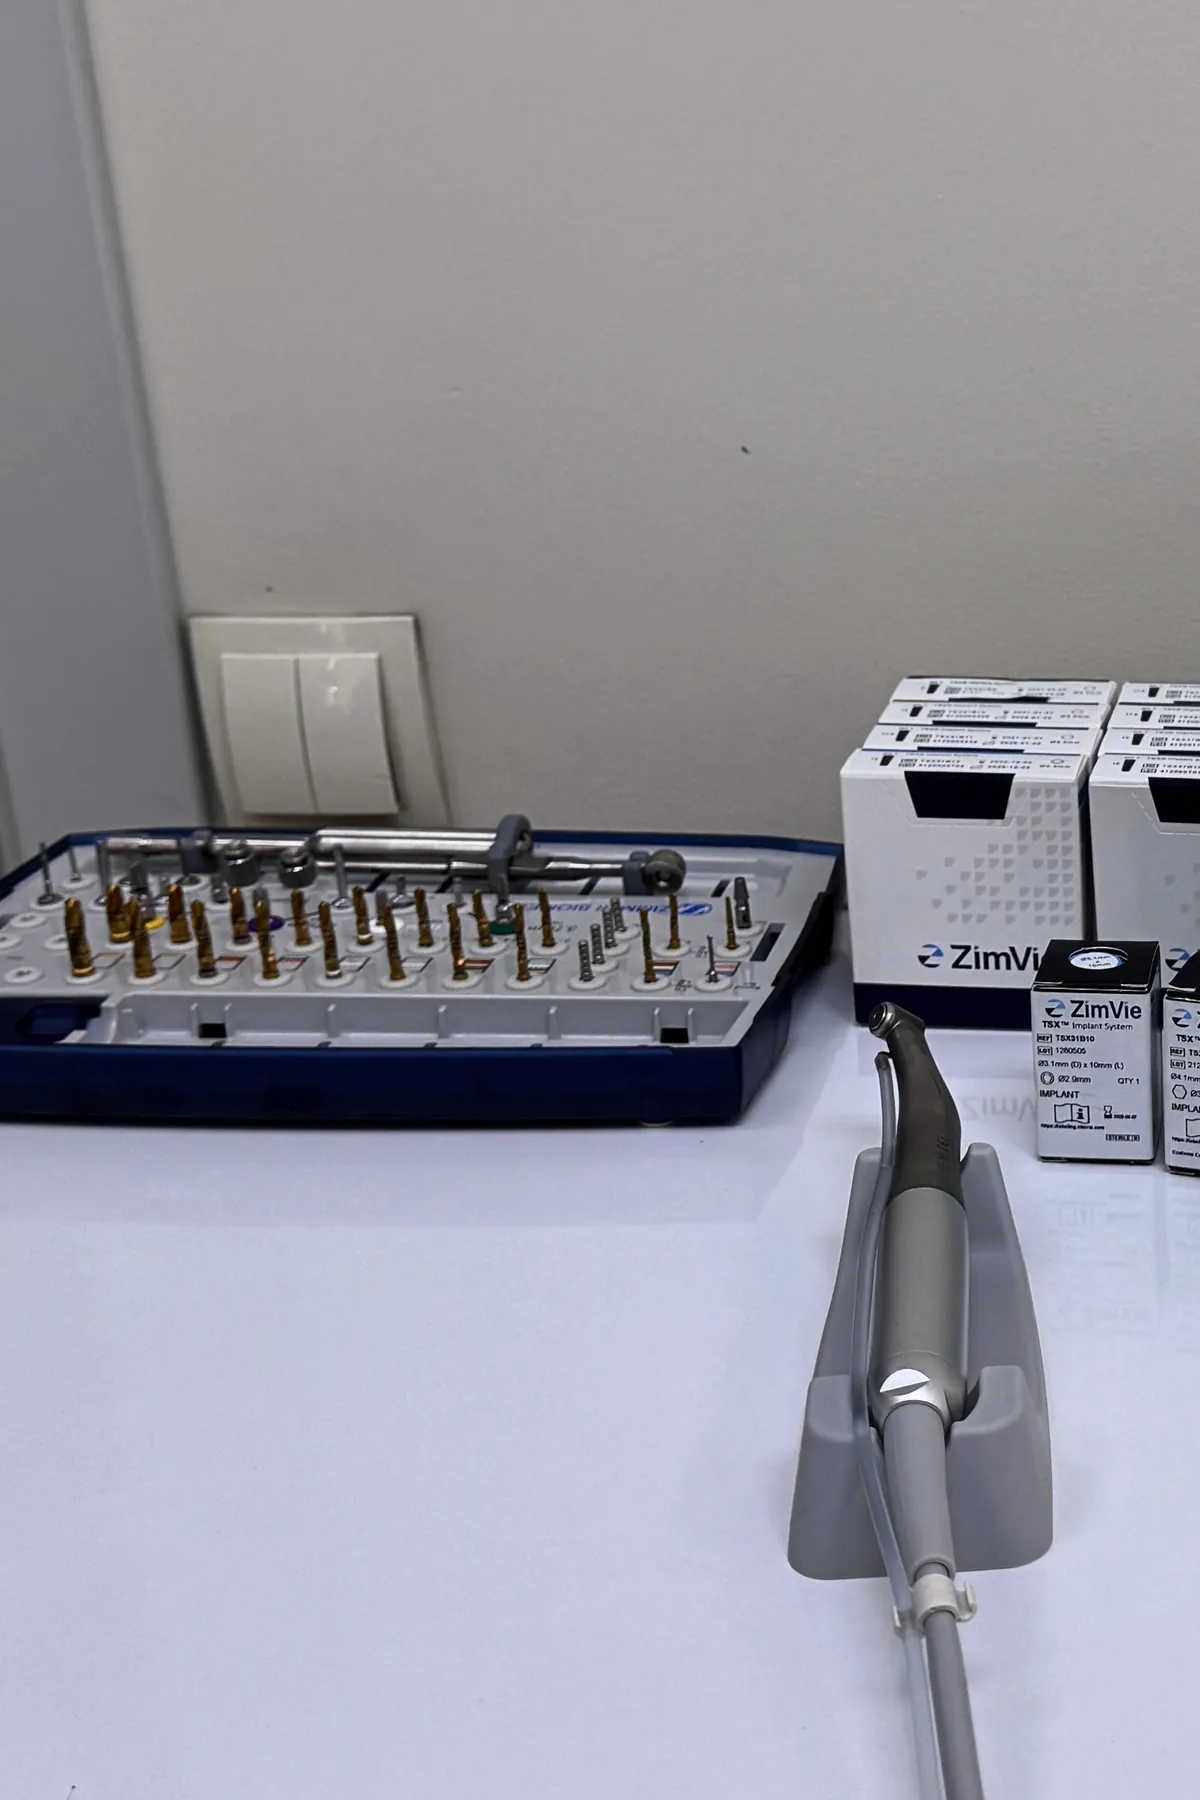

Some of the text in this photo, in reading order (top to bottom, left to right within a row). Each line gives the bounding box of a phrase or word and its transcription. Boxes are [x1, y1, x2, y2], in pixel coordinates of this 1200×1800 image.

[950, 944, 1039, 971] ZimVi
[1070, 1000, 1142, 1019] ZimVie
[1072, 1022, 1102, 1031] Implant
[1104, 1023, 1133, 1031] System
[1114, 1062, 1124, 1070] (L)
[1040, 1090, 1080, 1098] IMPLANT
